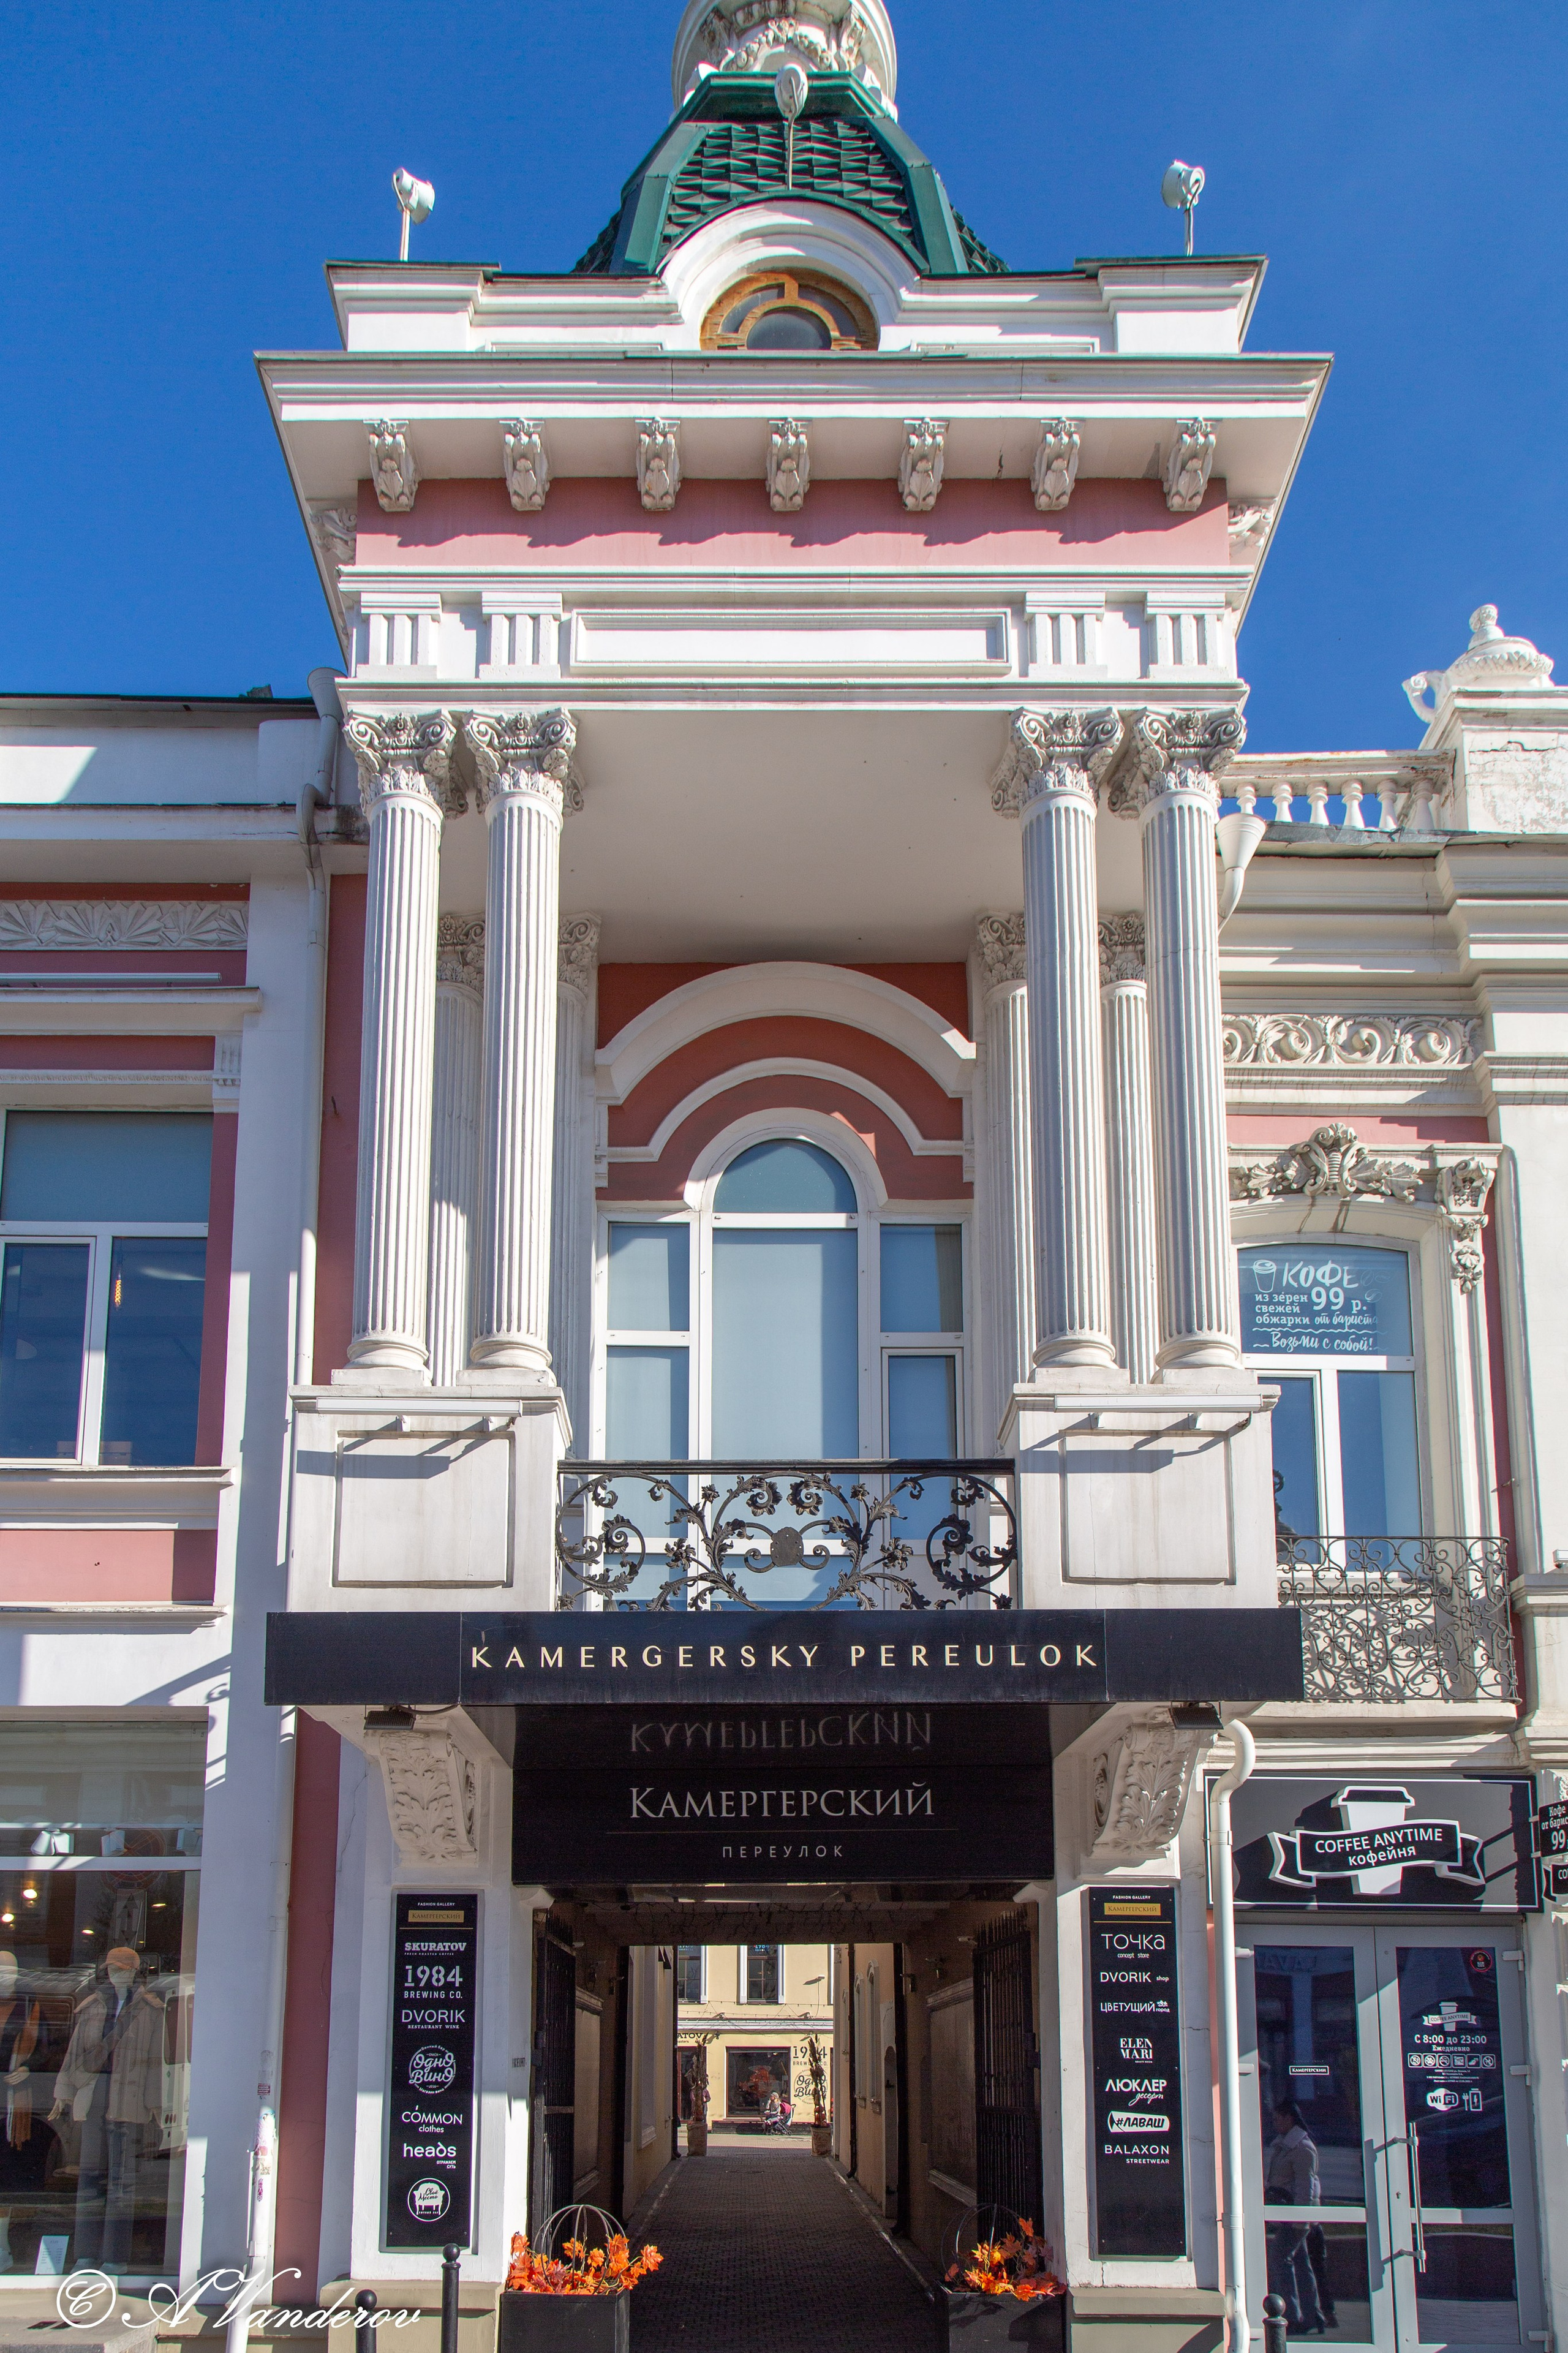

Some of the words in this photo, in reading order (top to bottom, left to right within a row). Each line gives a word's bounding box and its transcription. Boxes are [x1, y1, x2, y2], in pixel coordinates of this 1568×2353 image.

[1283, 1260, 1359, 1288] КОФЕ
[1311, 1286, 1344, 1310] 99
[1351, 1299, 1366, 1313] р.
[1256, 1303, 1300, 1313] свежей
[1256, 1313, 1310, 1326] обжарки
[1315, 1313, 1330, 1324] от
[1333, 1312, 1378, 1331] бариста
[1271, 1331, 1319, 1352] Возьми
[1323, 1339, 1330, 1348] с
[1334, 1335, 1373, 1351] собой!
[471, 1645, 819, 1668] KAMERGERSKY
[851, 1645, 1098, 1667] PEREULOK
[630, 1781, 934, 1819] КАМЕРГЕРСКИЙ
[1549, 1805, 1566, 1817] Кофе
[1541, 1821, 1548, 1830] от
[1315, 1837, 1370, 1853] COFFEE
[1374, 1828, 1442, 1846] ANYTIME
[1551, 1830, 1566, 1850] 99
[722, 1845, 844, 1859] ПЕРЕУЛОК
[1348, 1845, 1416, 1867] кофейня
[405, 1942, 467, 1951] SKURATOV
[405, 1965, 463, 1987] 1984
[1100, 1972, 1152, 1982] DVORIK
[1101, 2001, 1155, 2013] ЦВЕТУЩИЙ
[402, 2010, 466, 2022] DVORIK
[1120, 2038, 1153, 2048] ELEN
[1423, 2034, 1444, 2043] 8:00
[1460, 2035, 1487, 2044] 23:00
[793, 2046, 827, 2058] 194
[1120, 2049, 1153, 2059] MARI
[1105, 2079, 1167, 2091] ЛЮКЛЕР
[1128, 2092, 1164, 2106] десерт
[419, 2124, 444, 2133] clothes
[1116, 2117, 1165, 2128] #ЛАВАШ
[403, 2142, 456, 2158] heads
[1104, 2145, 1169, 2155] BALAXON
